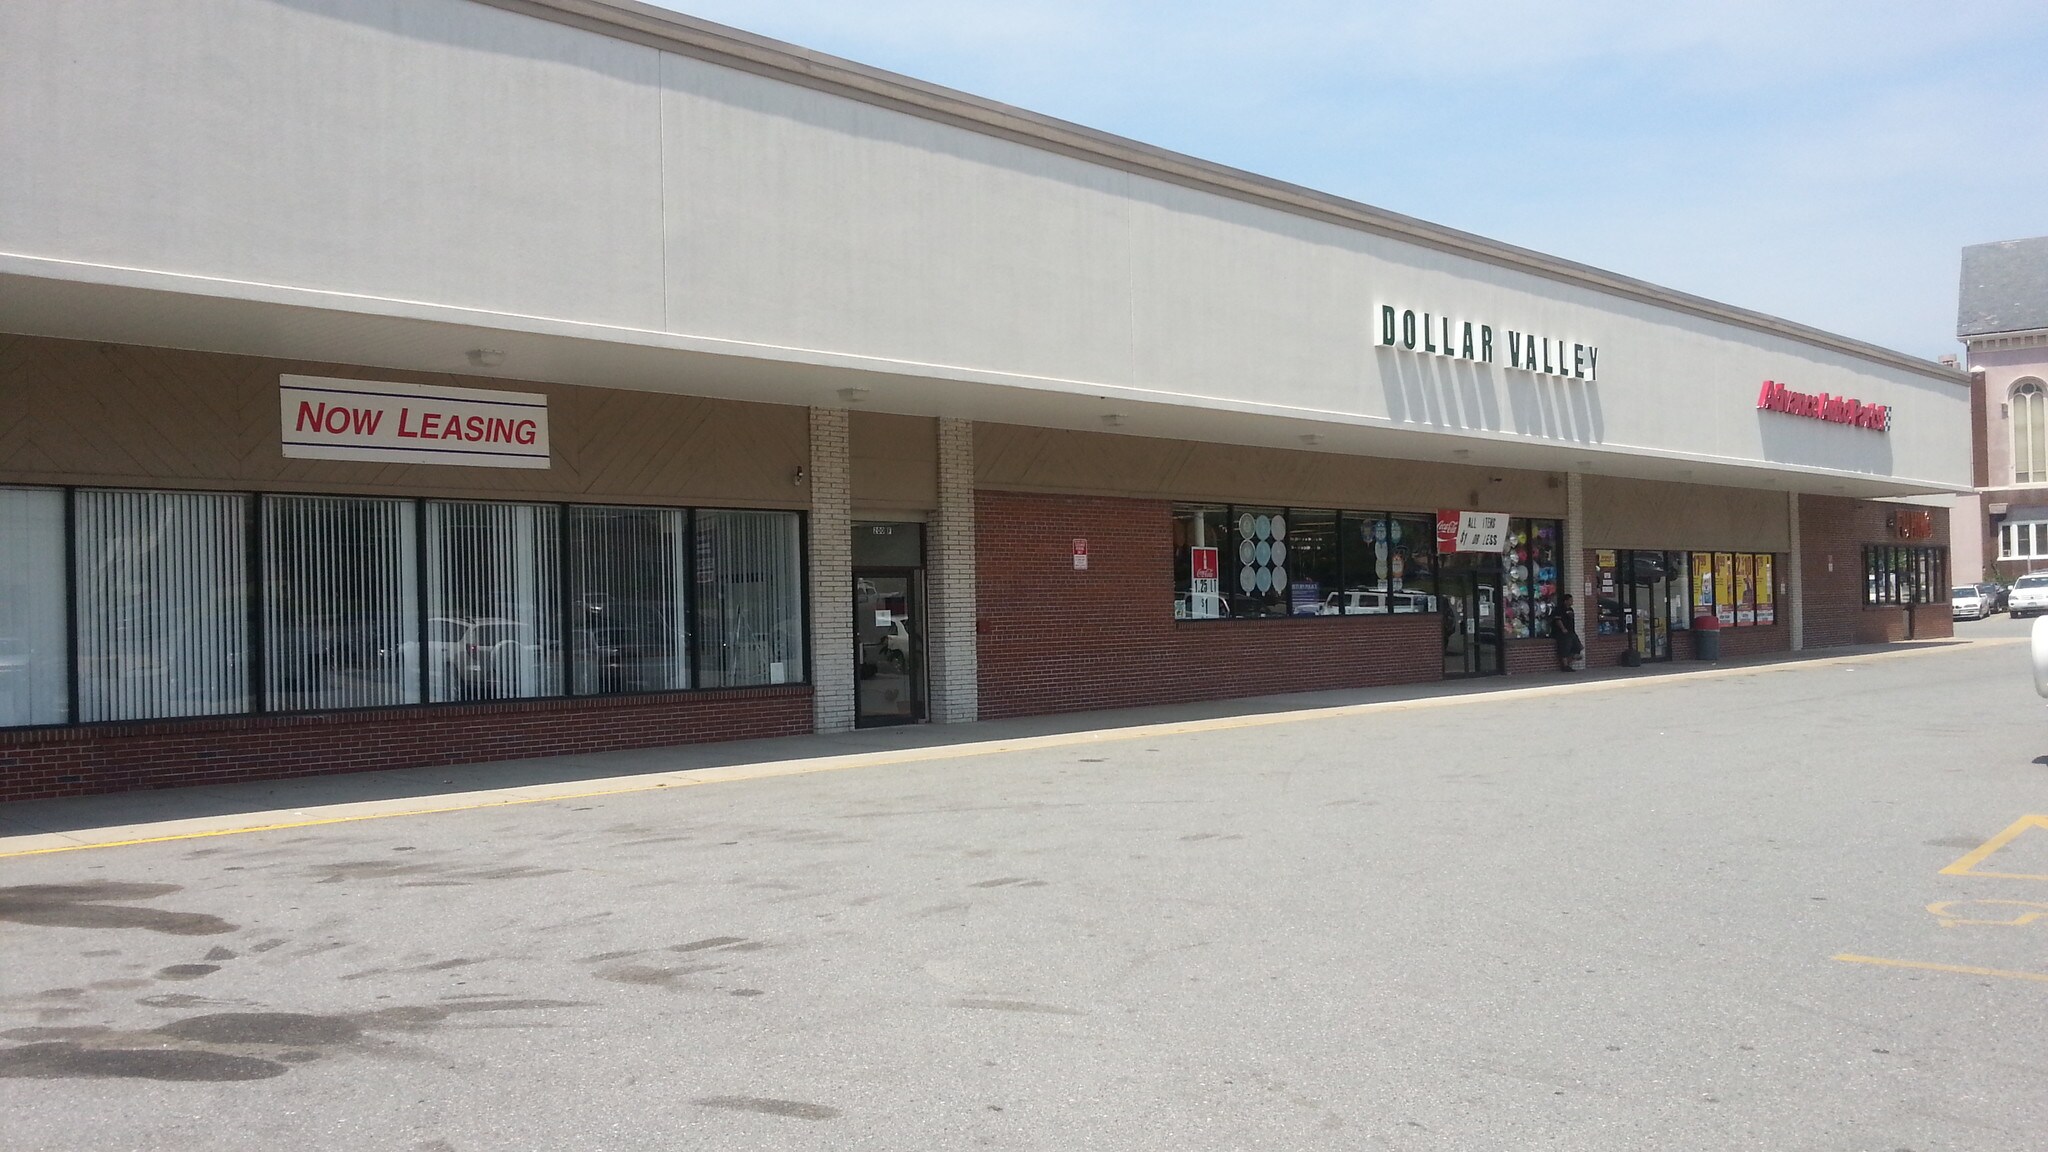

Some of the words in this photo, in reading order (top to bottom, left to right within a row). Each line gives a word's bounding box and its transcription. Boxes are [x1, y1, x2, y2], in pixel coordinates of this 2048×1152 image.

[1380, 304, 1493, 363] DOLLAR
[1507, 330, 1599, 382] VALLEY
[295, 401, 384, 436] NOW
[397, 407, 537, 446] LEASING
[1467, 517, 1477, 529] ALL
[1482, 517, 1497, 529] ITEMS
[1460, 530, 1468, 545] $1
[1482, 534, 1498, 546] LESS
[1195, 579, 1208, 593] 1.25
[1211, 579, 1217, 593] LT
[1201, 598, 1208, 615] $1
